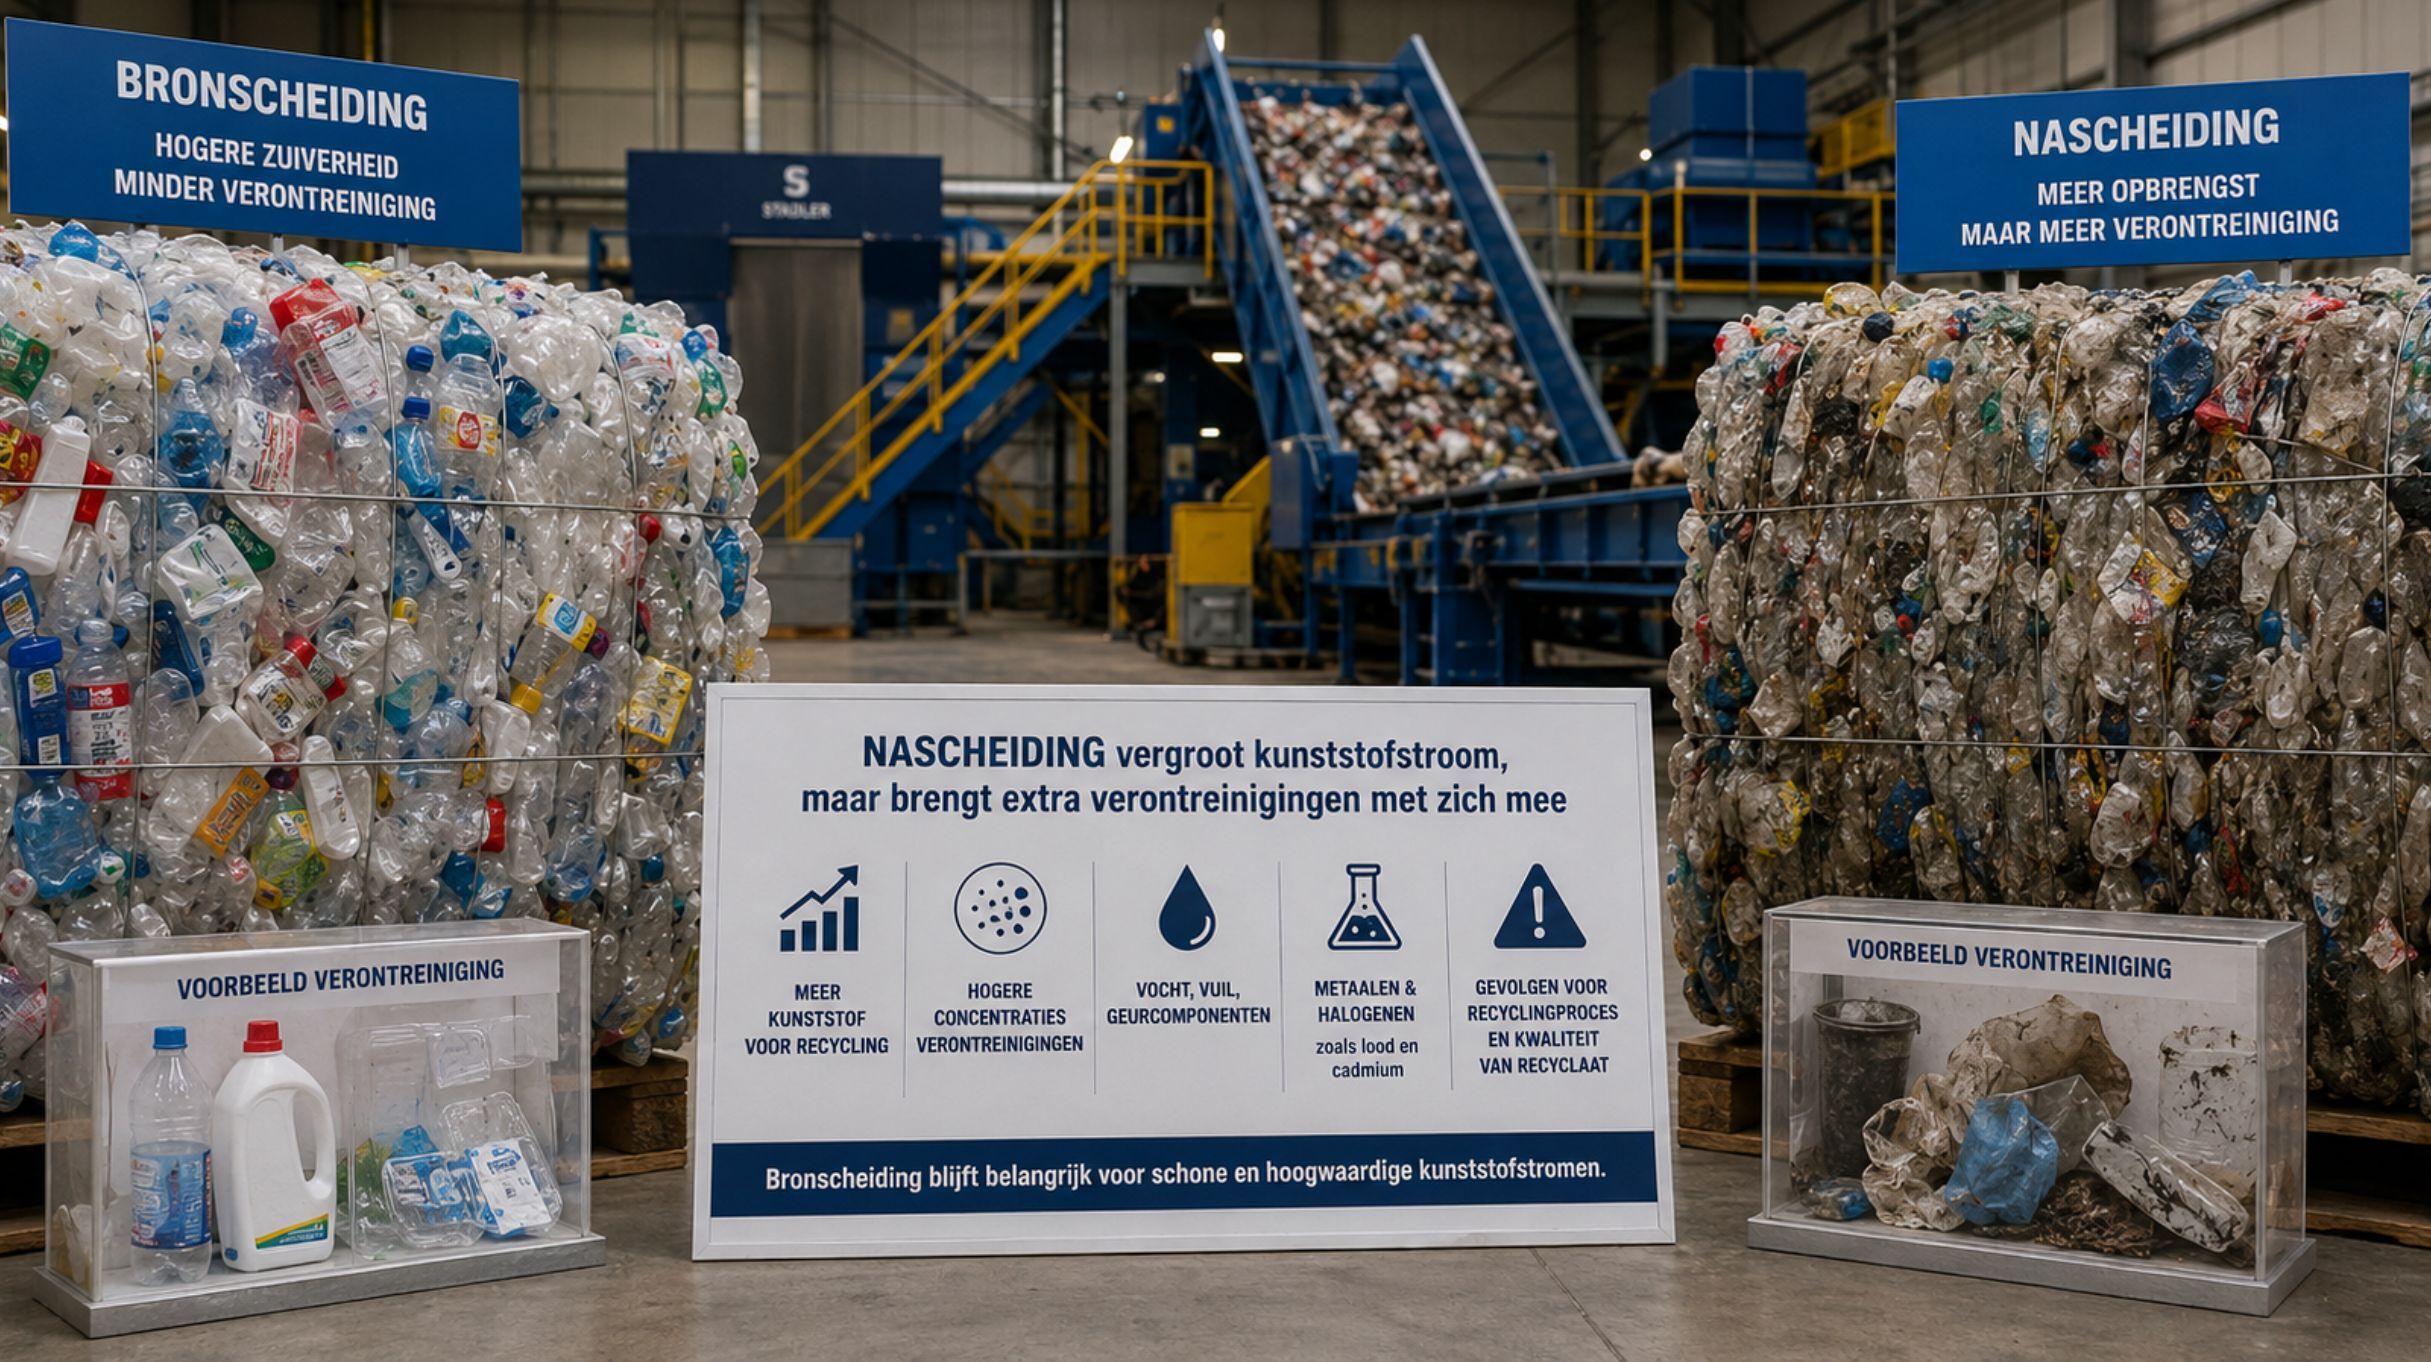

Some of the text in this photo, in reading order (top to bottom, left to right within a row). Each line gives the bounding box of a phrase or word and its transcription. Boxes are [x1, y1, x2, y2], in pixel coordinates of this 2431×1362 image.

[116, 59, 427, 132] BRONSCHEIDING
[2014, 107, 2279, 157] NASCHEIDING
[155, 132, 399, 180] HOGERE ZUIVERHEID
[783, 165, 810, 198] S
[2038, 173, 2260, 206] MEER OPBRENGST
[114, 168, 436, 221] MINDER VERONTREINIGING
[1961, 208, 2339, 246] MAAR MEER VERONTREINIGING
[863, 734, 1508, 776] NASCHEIDING vergroot kunststofstroom,
[802, 781, 1567, 821] maar brengt extra verontreinigingen met zich mee
[1847, 938, 2172, 980] VOORBEELD VERONTREINIGING
[177, 958, 504, 1000] VOORBEELD VERONTREINIGING
[1314, 979, 1417, 997] METAALEN &
[1475, 978, 1608, 996] GEVOLGEN VOOR
[794, 983, 841, 1001] MEER
[967, 982, 1033, 1000] HOGERE
[1135, 981, 1241, 1001] VOCHT, VUIL,
[768, 1010, 867, 1028] KUNSTSTOF
[934, 1008, 1067, 1027] CONCENTRATIES
[1106, 1006, 1271, 1025] GEURCOMPONENTEN
[1318, 1005, 1415, 1023] HALOGENEN
[1467, 1004, 1619, 1022] RECYCLINGPROCES
[744, 1036, 889, 1055] VOOR RECYCLING
[916, 1035, 1084, 1054] VERONTREINIGINGEN
[1316, 1037, 1419, 1055] zoals lood en
[1488, 1030, 1600, 1048] EN KWALITEIT
[1331, 1060, 1404, 1079] cadmium
[1479, 1056, 1610, 1075] VAN RECYCLAAT
[766, 1156, 1607, 1194] Bronscheiding blijft belangrijk voor schone en hoogwaardige kunststofstromen.
